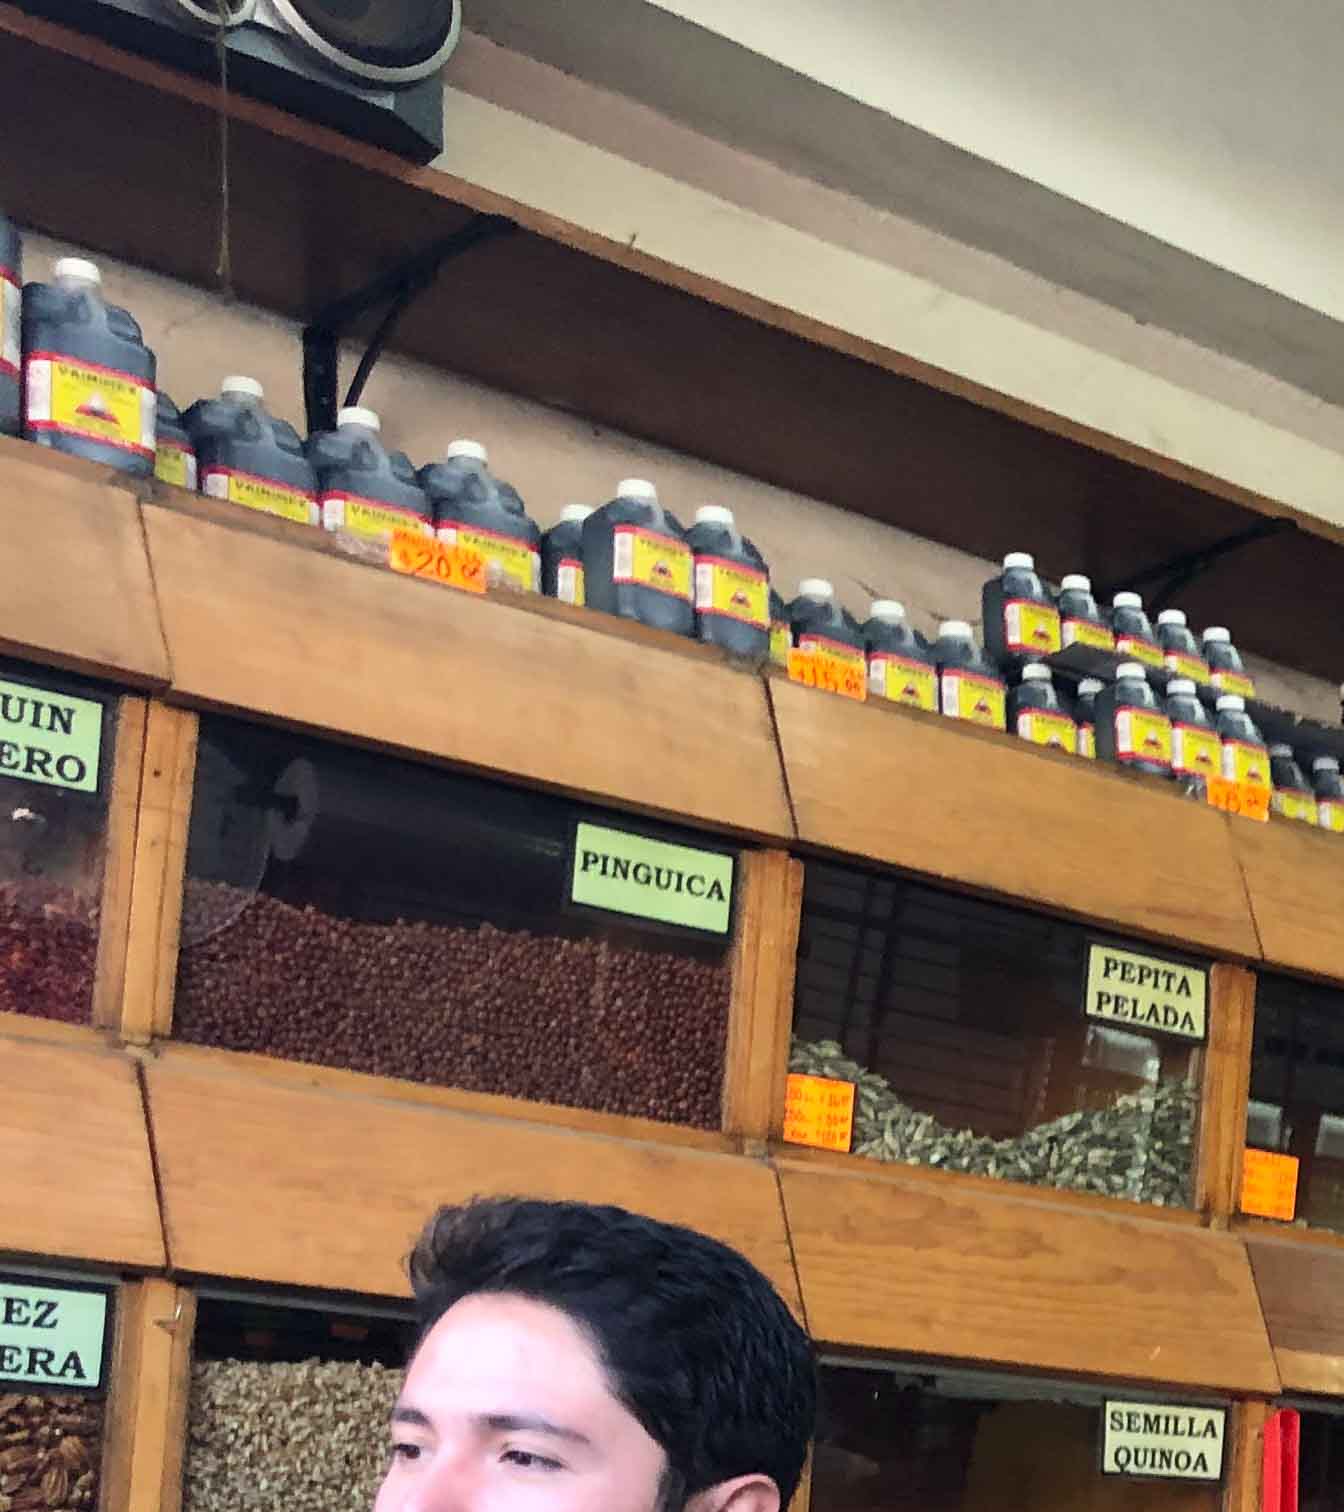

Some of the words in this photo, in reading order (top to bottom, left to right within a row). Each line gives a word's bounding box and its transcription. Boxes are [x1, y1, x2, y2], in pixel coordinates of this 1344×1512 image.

[579, 849, 727, 904] PINGUICA
[1102, 956, 1192, 998] PEPITA
[1094, 990, 1196, 1033] PELADA
[1110, 1410, 1218, 1441] SEMILLA
[1114, 1446, 1210, 1475] QUINOA
